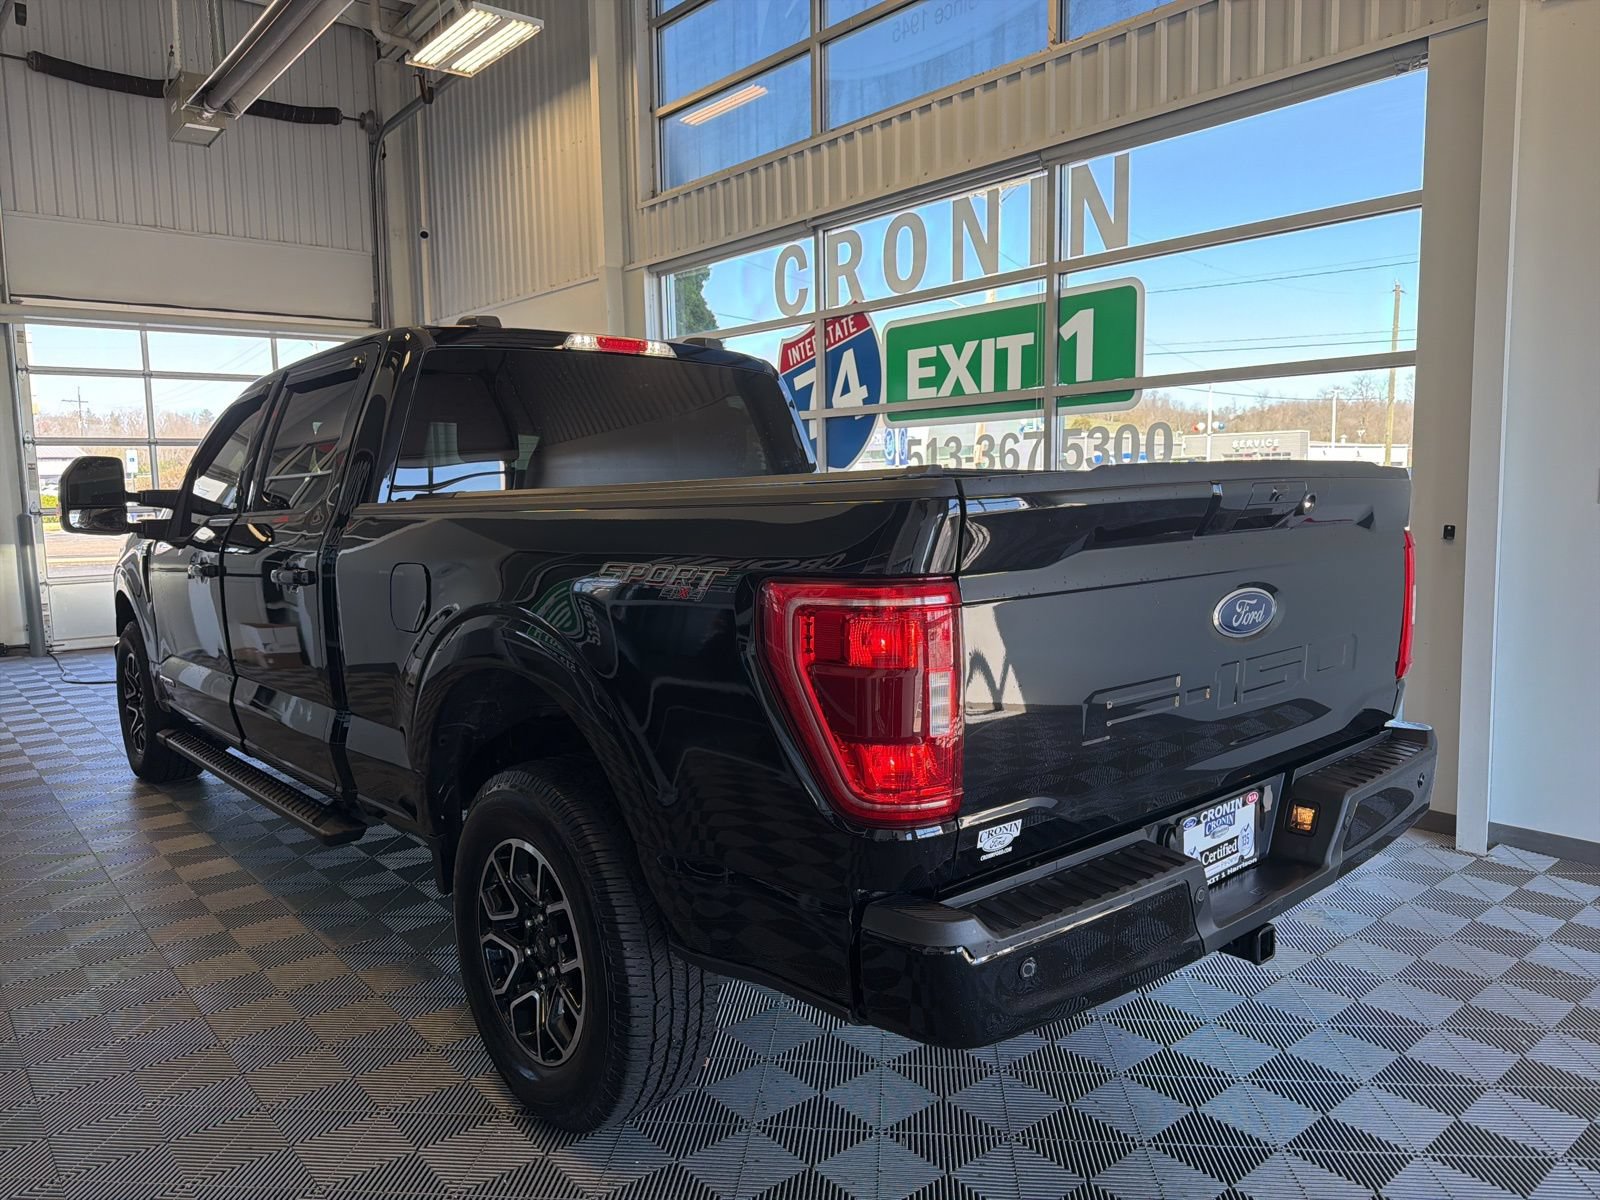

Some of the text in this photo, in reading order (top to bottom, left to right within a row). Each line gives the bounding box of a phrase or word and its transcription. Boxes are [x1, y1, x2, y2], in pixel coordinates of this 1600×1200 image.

[775, 152, 1130, 317] CRONIN
[787, 314, 858, 367] INTETATE
[1058, 307, 1095, 382] 1
[906, 331, 1035, 401] EXIT
[793, 348, 869, 440] 74
[1231, 438, 1280, 449] SERVICE
[599, 561, 729, 589] SPORT
[1232, 598, 1266, 628] Ford
[1200, 797, 1243, 823] CRONIN
[1205, 812, 1235, 835] CRONIN
[979, 821, 1020, 842] CRONIN
[1201, 838, 1238, 867] Certified
[1206, 874, 1220, 885] XIT
[1227, 857, 1258, 875] Harrison
